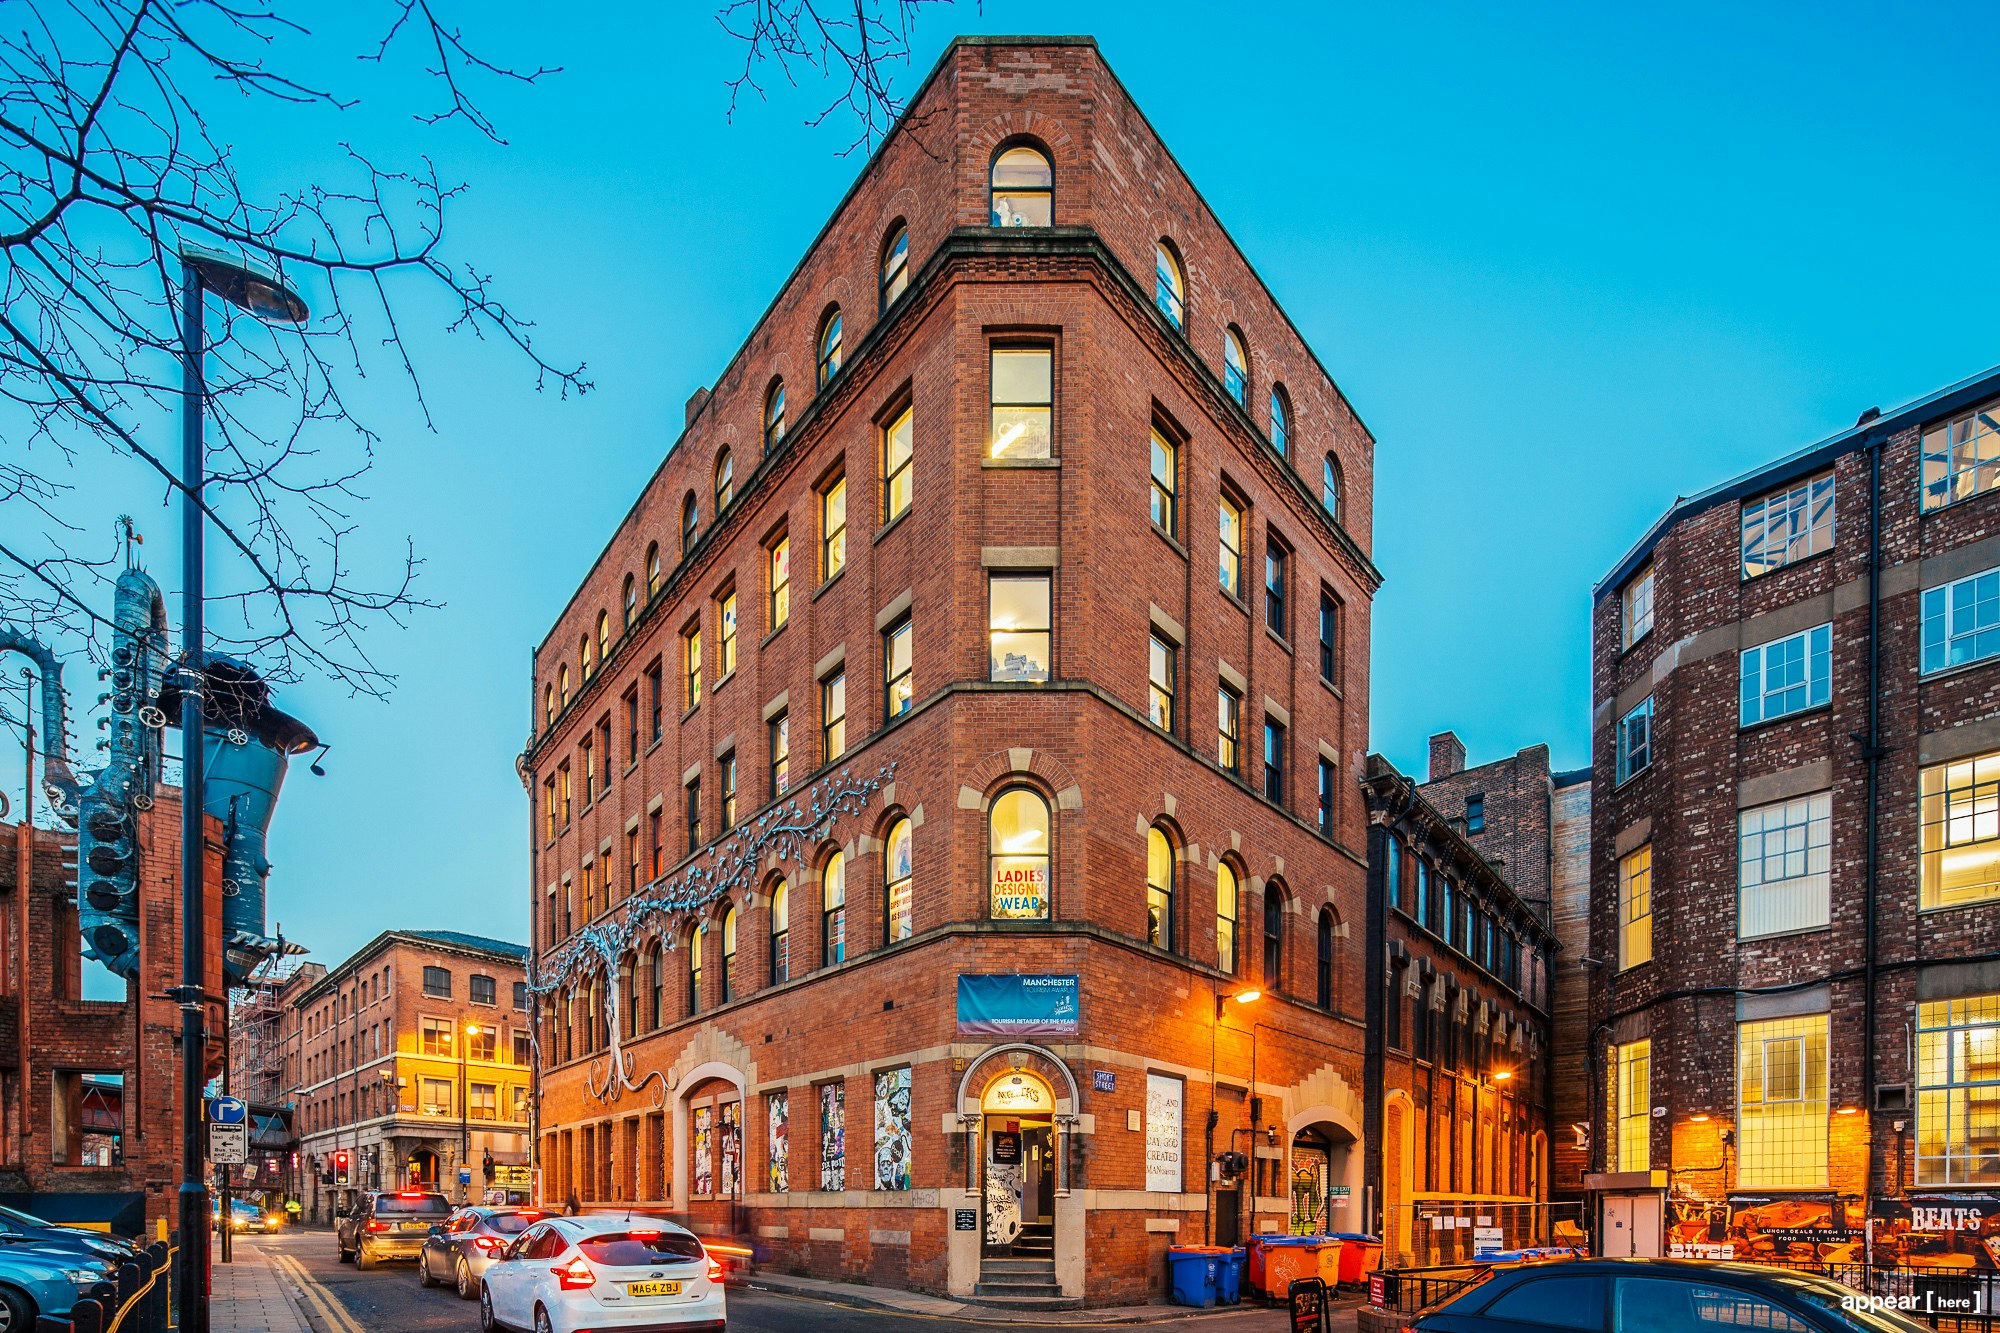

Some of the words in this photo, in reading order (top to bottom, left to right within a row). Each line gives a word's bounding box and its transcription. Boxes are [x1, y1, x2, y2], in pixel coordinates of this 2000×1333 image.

[997, 870, 1044, 883] LADIES
[994, 883, 1047, 896] DESIGNER
[1000, 896, 1040, 910] WEAR
[1023, 978, 1075, 987] MANCHESTER
[1096, 1072, 1114, 1081] SHORT
[1095, 1080, 1115, 1091] STREET
[1163, 1137, 1178, 1149] GOD
[1146, 1150, 1179, 1163] CREATED
[1911, 1207, 1982, 1231] BEATS
[632, 1284, 658, 1294] MA64
[660, 1282, 679, 1293] ZBJ
